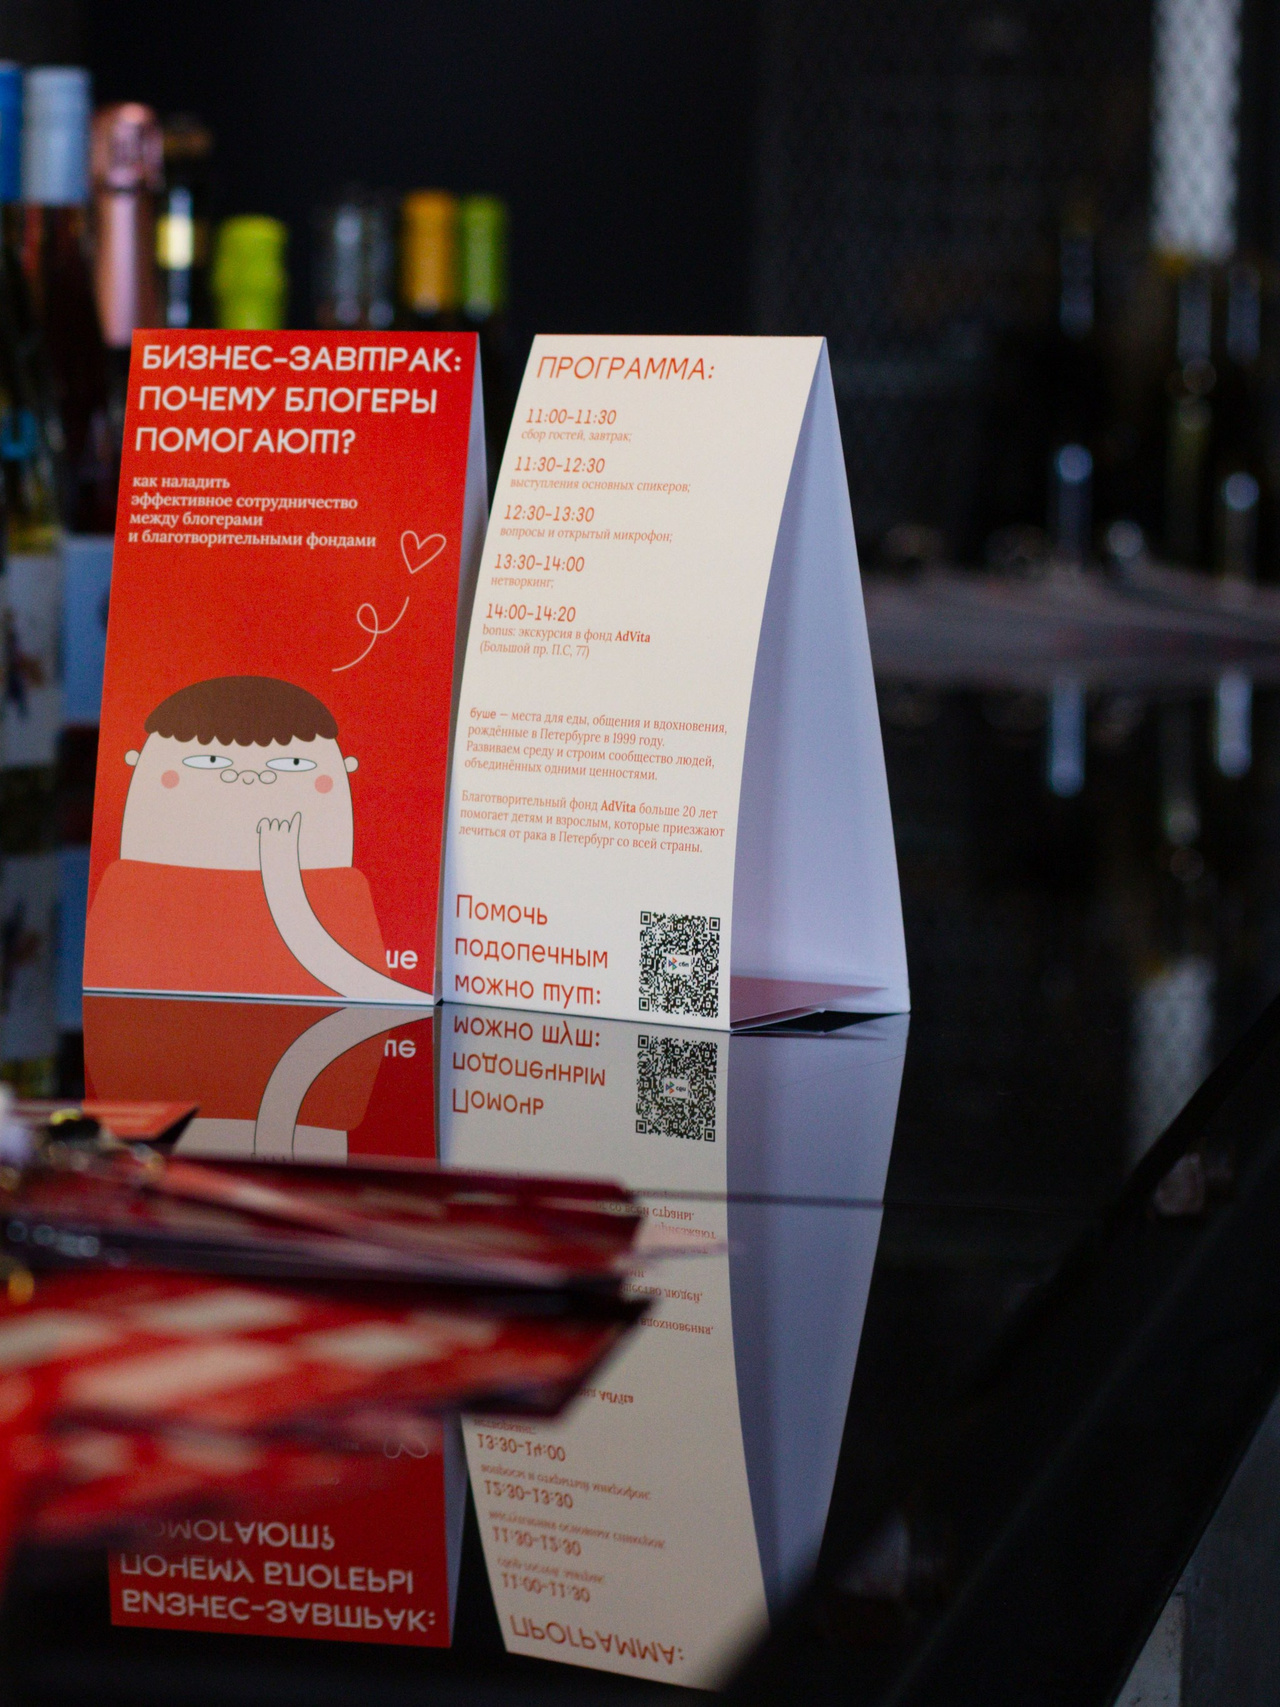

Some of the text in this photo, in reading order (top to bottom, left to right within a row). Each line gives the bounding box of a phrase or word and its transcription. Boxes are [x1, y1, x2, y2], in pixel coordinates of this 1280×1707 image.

[142, 344, 462, 372] БИЗНЕС-ЗАВТРАК:
[536, 357, 715, 380] ПРОГРАММА:
[139, 386, 438, 414] ПОЧЕМУ БЛОГЕРЫ
[134, 427, 356, 454] ПОМОГАЮТ?
[521, 429, 632, 444] сбор гостей, завтрак;
[132, 477, 230, 490] как наладить
[510, 478, 691, 495] выступления основных спикеров;
[131, 492, 358, 511] эффективное сотрудничество
[129, 511, 263, 528] между блогерами
[128, 529, 376, 549] и благотворительными фондами
[500, 527, 673, 545] вопросы и открытый микрофон;
[491, 576, 555, 589] нетворкинг;
[482, 624, 651, 644] bonus: экскурсия в фонд AdVita
[480, 640, 531, 654] (Большой
[533, 645, 548, 658] пр.
[576, 645, 590, 660] 77)
[470, 708, 496, 720] буше
[511, 710, 542, 722] места
[544, 713, 563, 724] для
[566, 714, 590, 726] еды,
[592, 715, 640, 729] общения
[642, 719, 650, 728] и
[653, 720, 728, 734] вдохновения,
[468, 726, 664, 748] рождённые в Петербурге в 1999 году.
[466, 741, 715, 768] Развиваем среду и строим сообщество людей,
[464, 758, 658, 780] объединённых одними ценностями.
[462, 790, 718, 819] Благотворительный фонд AdVita больше 20 лет
[460, 808, 725, 838] помогает детям и взрослым, которые приезжают
[459, 825, 702, 854] лечиться от рака в Петербург со всей страны.
[455, 894, 548, 926] Помочь
[455, 938, 608, 968] подопечным
[455, 974, 601, 1009] можно тут:
